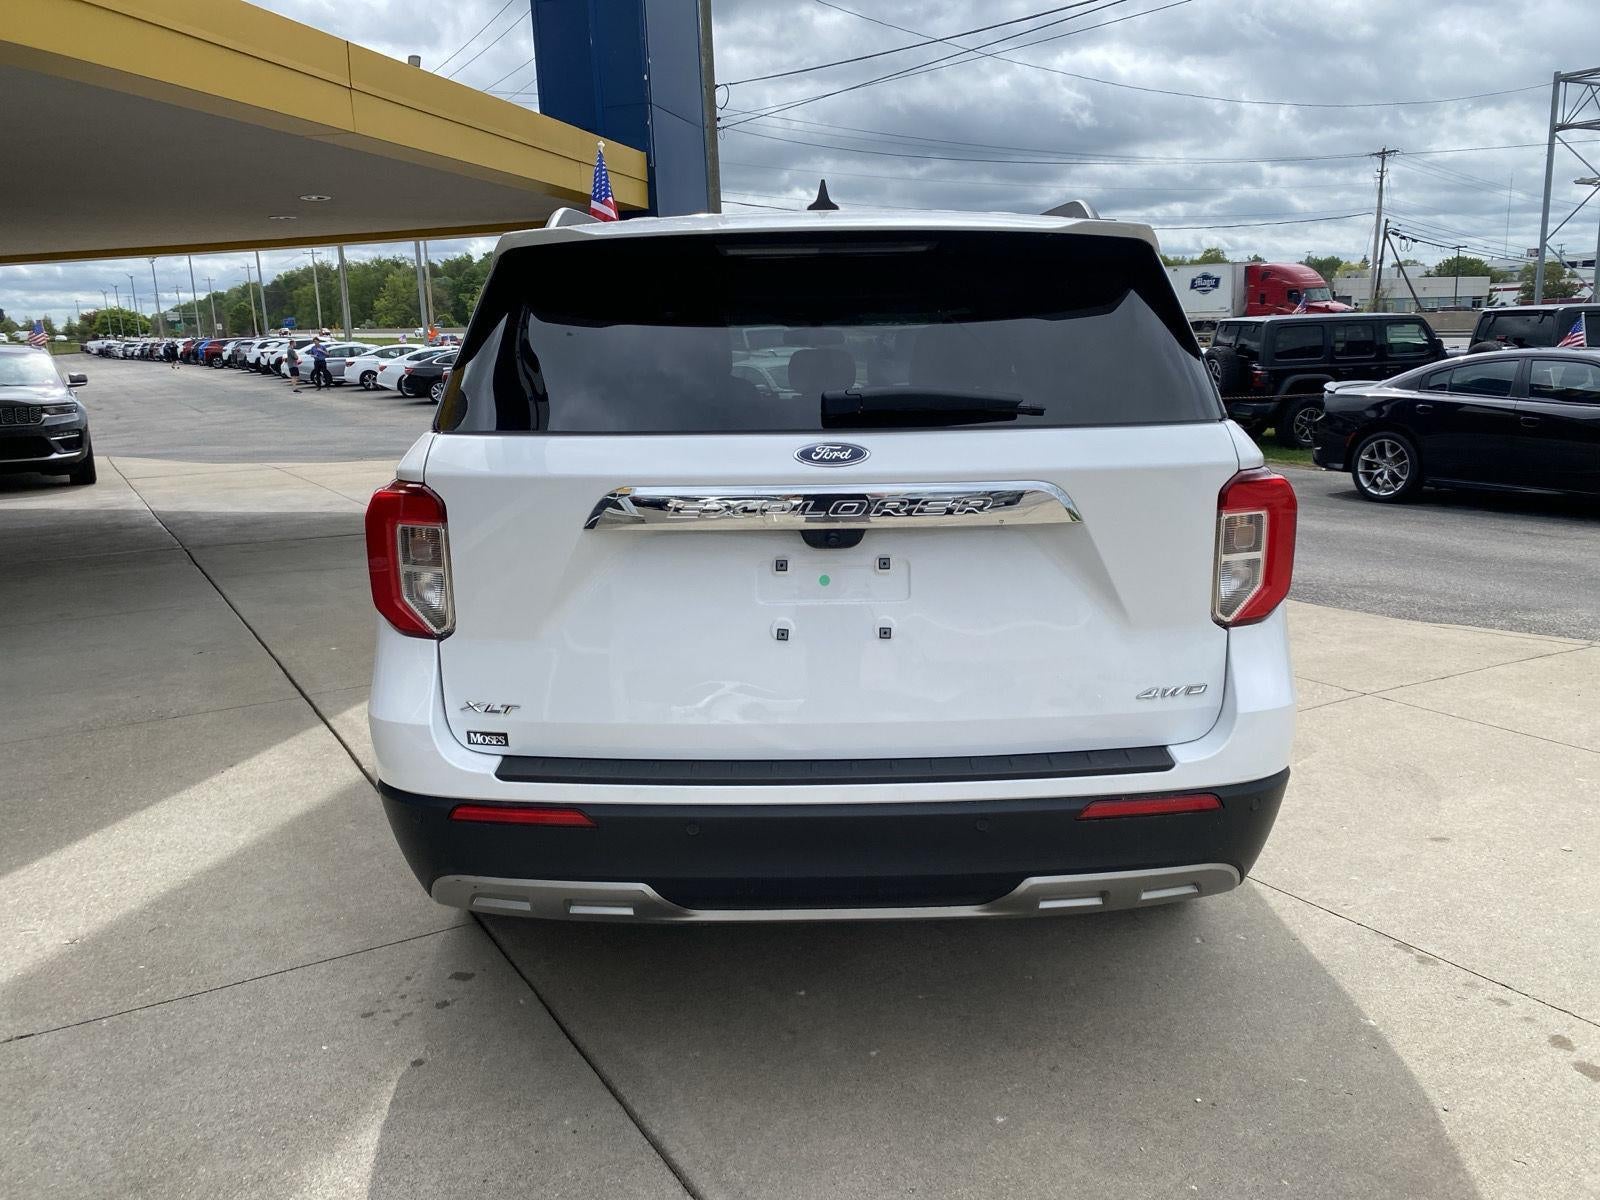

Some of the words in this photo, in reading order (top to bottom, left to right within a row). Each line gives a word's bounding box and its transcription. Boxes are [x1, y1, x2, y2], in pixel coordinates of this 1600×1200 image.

[811, 445, 852, 460] Ford
[666, 499, 994, 519] EXPLORER
[1135, 683, 1208, 700] 4WD
[460, 701, 520, 715] XLT
